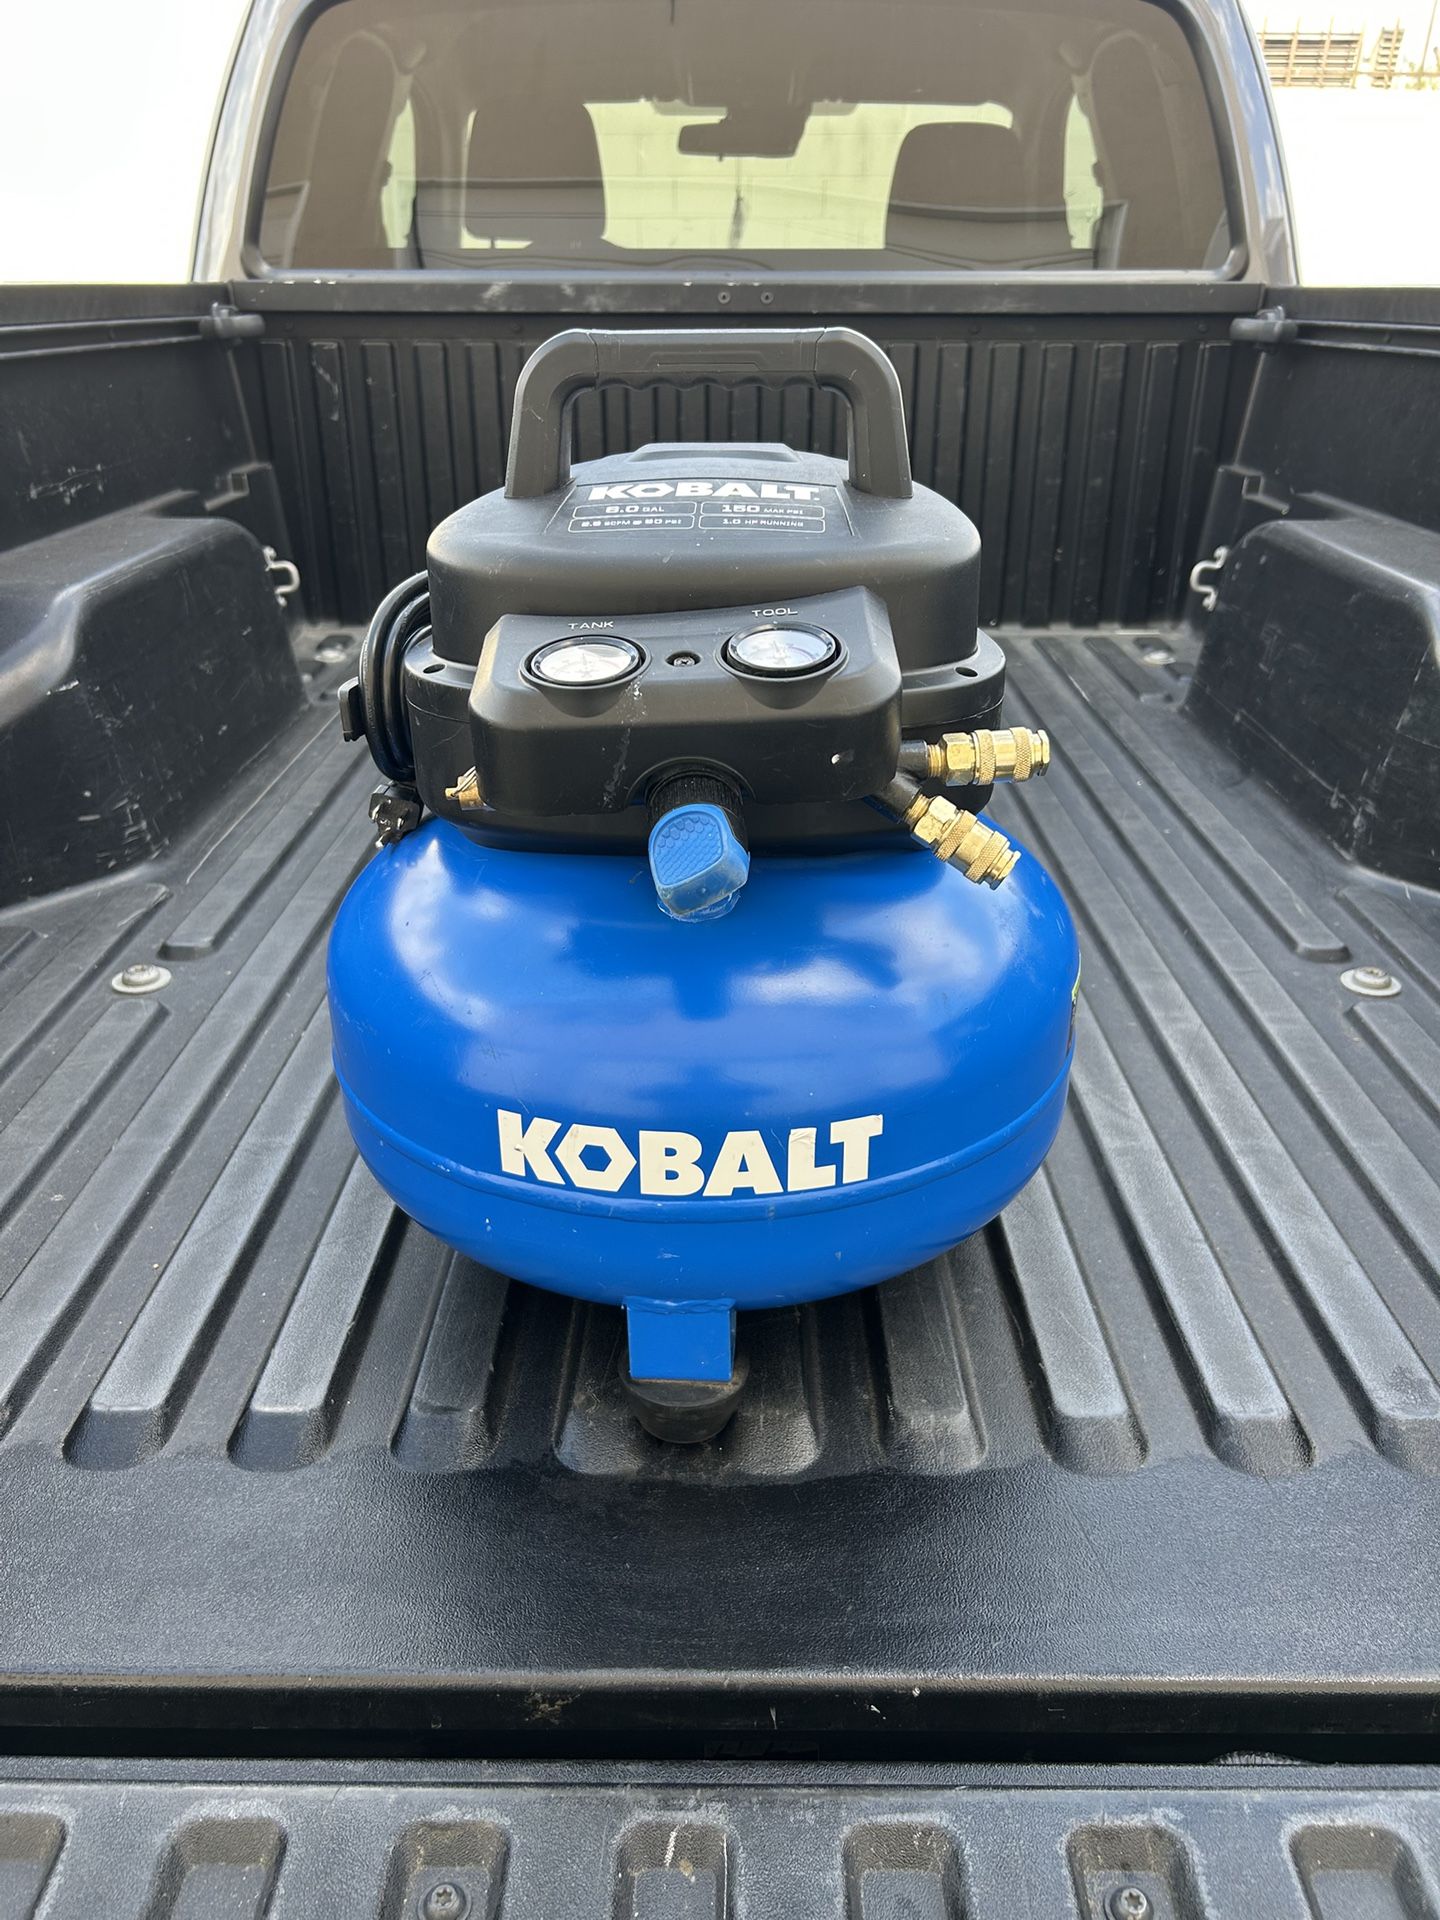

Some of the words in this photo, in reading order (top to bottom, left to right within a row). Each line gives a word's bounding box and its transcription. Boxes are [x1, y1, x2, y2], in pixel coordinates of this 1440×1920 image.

[588, 482, 820, 501] KOBALT
[722, 504, 760, 513] 150
[759, 519, 804, 527] RUNNING
[752, 608, 798, 617] TOOL
[568, 621, 614, 630] TANK
[497, 1109, 883, 1197] KOBALT
